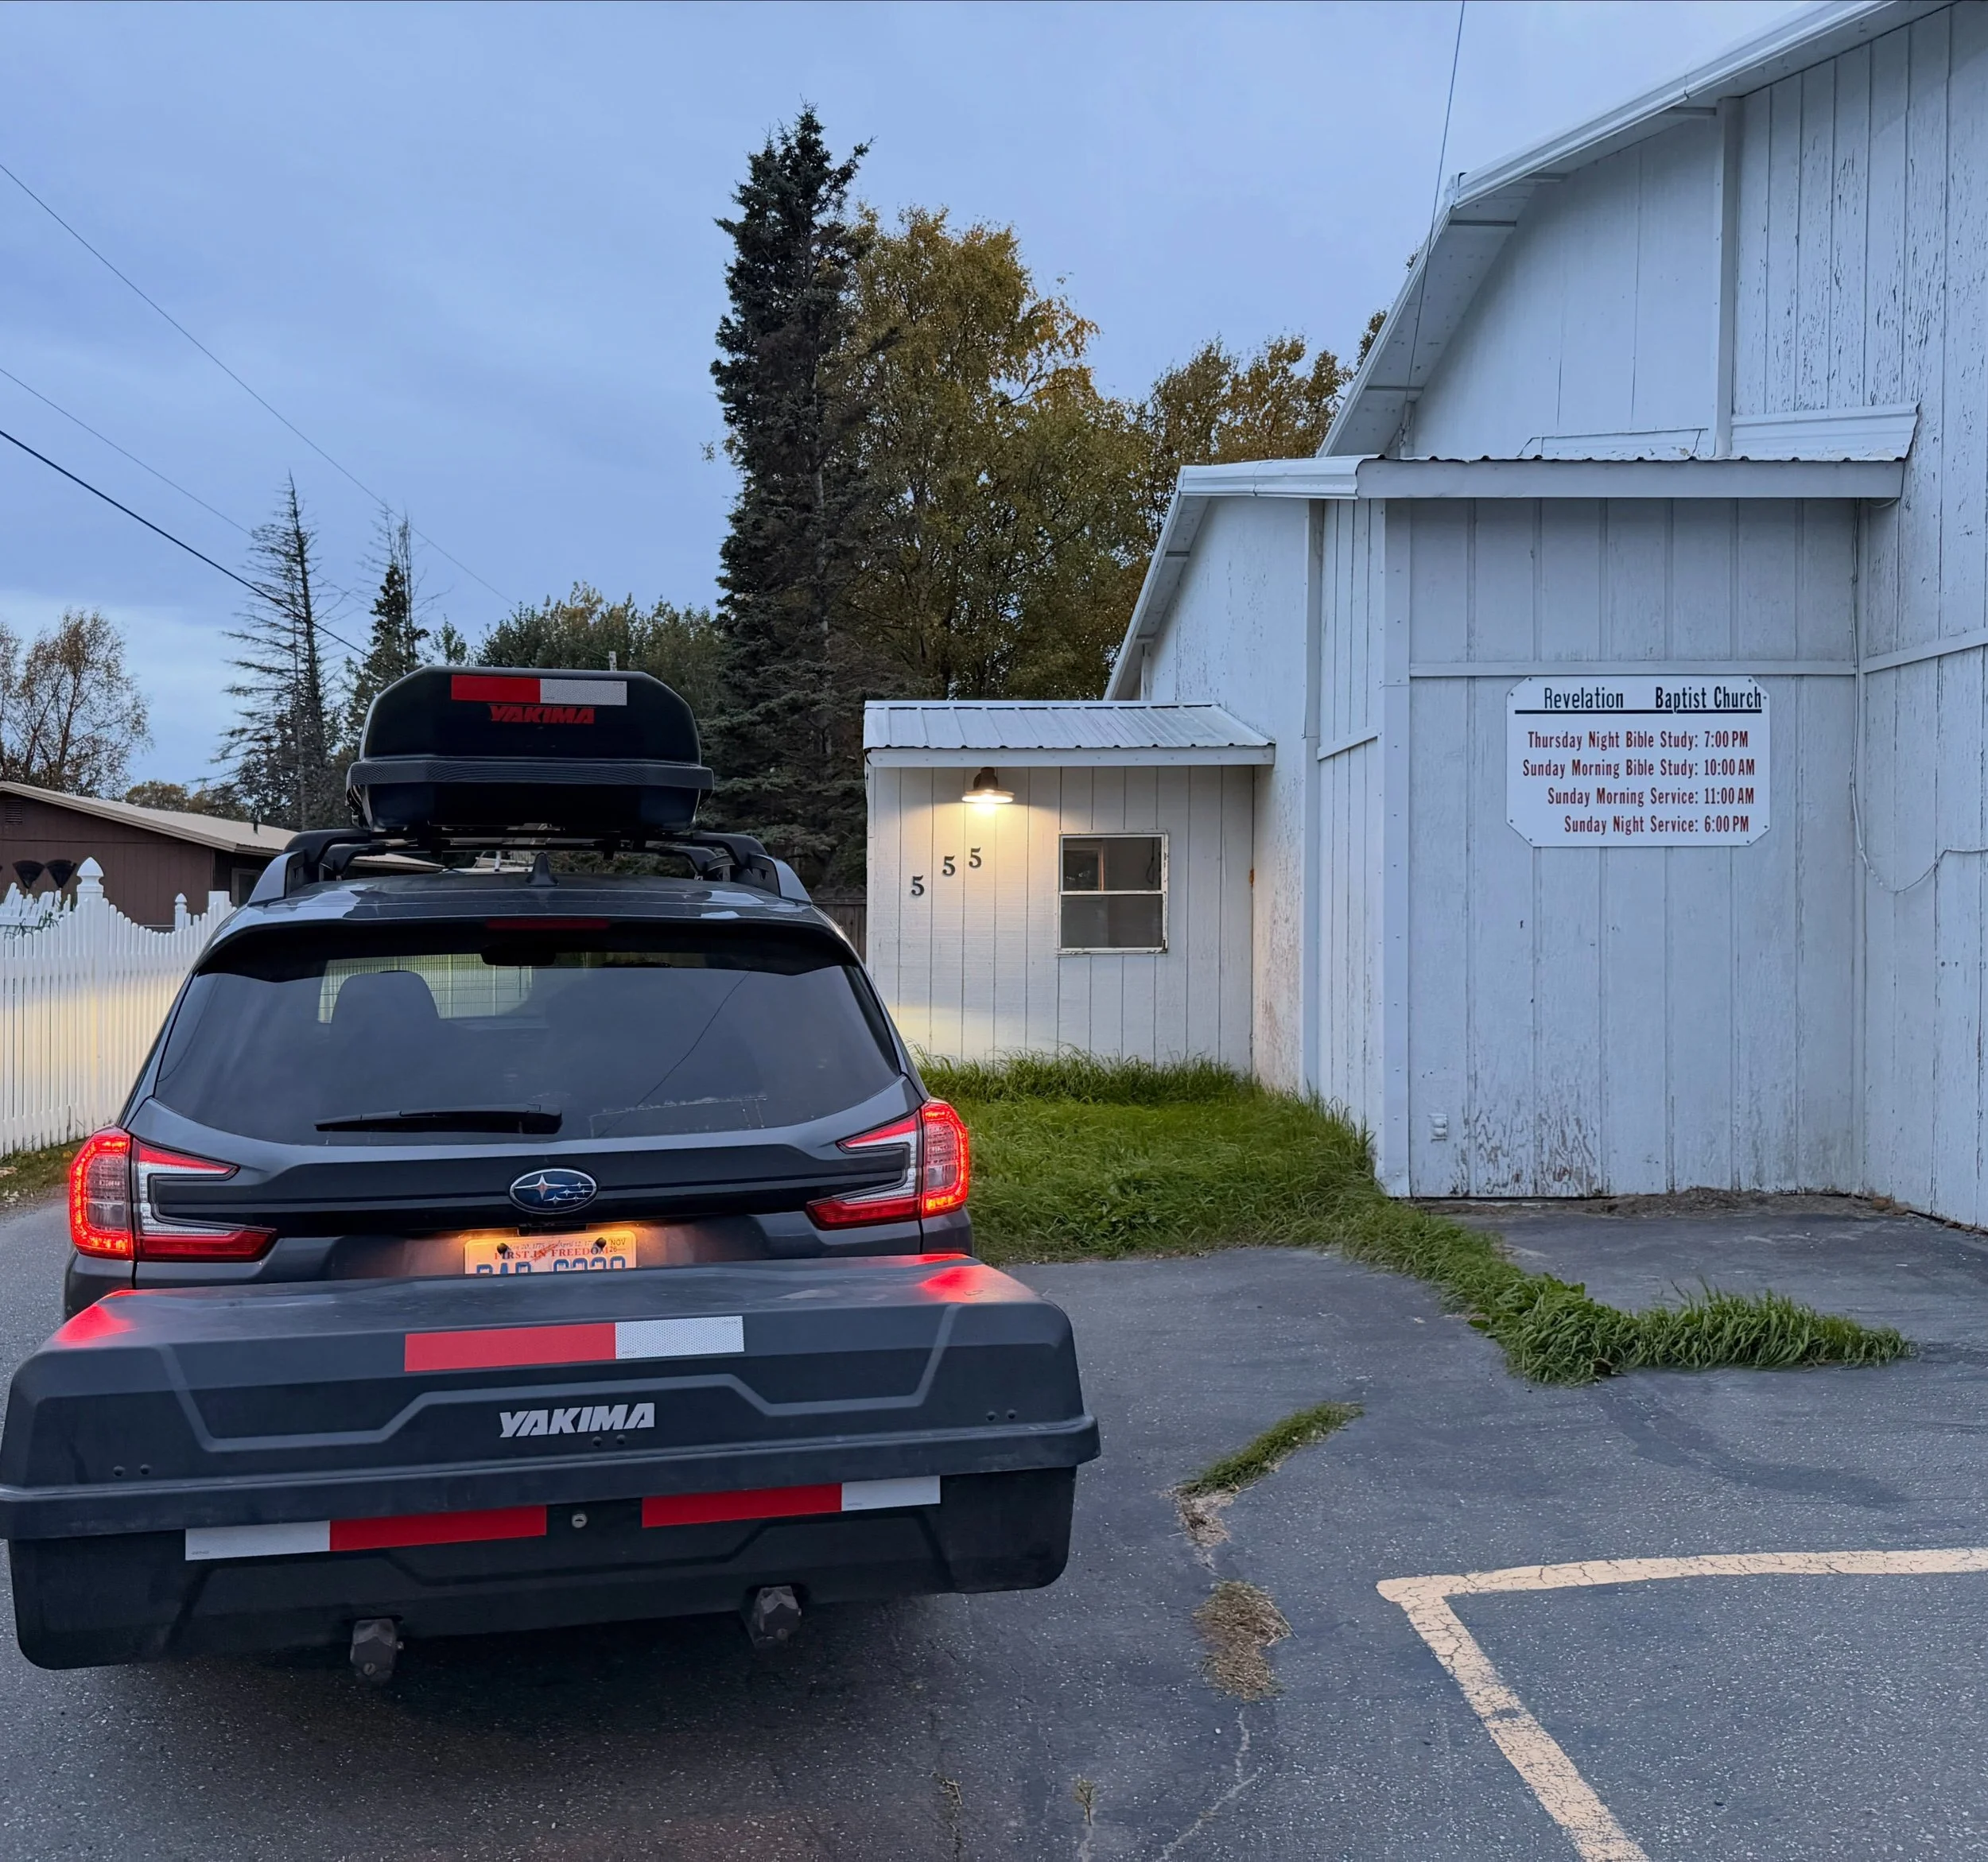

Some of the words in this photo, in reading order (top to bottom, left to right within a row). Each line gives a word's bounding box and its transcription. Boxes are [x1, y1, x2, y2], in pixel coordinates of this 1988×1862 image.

[1545, 687, 1623, 708] Revelation
[1656, 687, 1706, 712] Baptist
[1714, 686, 1761, 708] Church
[489, 704, 595, 724] YAKIMA
[1528, 731, 1582, 751] Thursday
[1589, 731, 1619, 751] Night
[1626, 731, 1653, 747] Bible
[1660, 731, 1698, 751] Study:
[1705, 731, 1729, 747] 7:00
[1732, 731, 1748, 747] PM
[1524, 759, 1565, 779] Sunday
[1572, 759, 1619, 778] Morning
[1626, 759, 1653, 775] Bible
[1660, 759, 1698, 778] Study:
[1705, 759, 1735, 775] 10:00
[1738, 759, 1754, 775] AM
[1548, 788, 1590, 807] Sunday
[1597, 788, 1644, 807] Morning
[1651, 788, 1698, 804] Service:
[1705, 788, 1734, 804] 11:00
[1738, 788, 1753, 804] AM
[1565, 816, 1606, 835] Sunday
[1613, 816, 1644, 836] Night
[1651, 816, 1698, 832] Service:
[1705, 816, 1729, 832] 6:00
[1733, 816, 1749, 832] PM
[499, 1402, 655, 1437] YAKIMA
